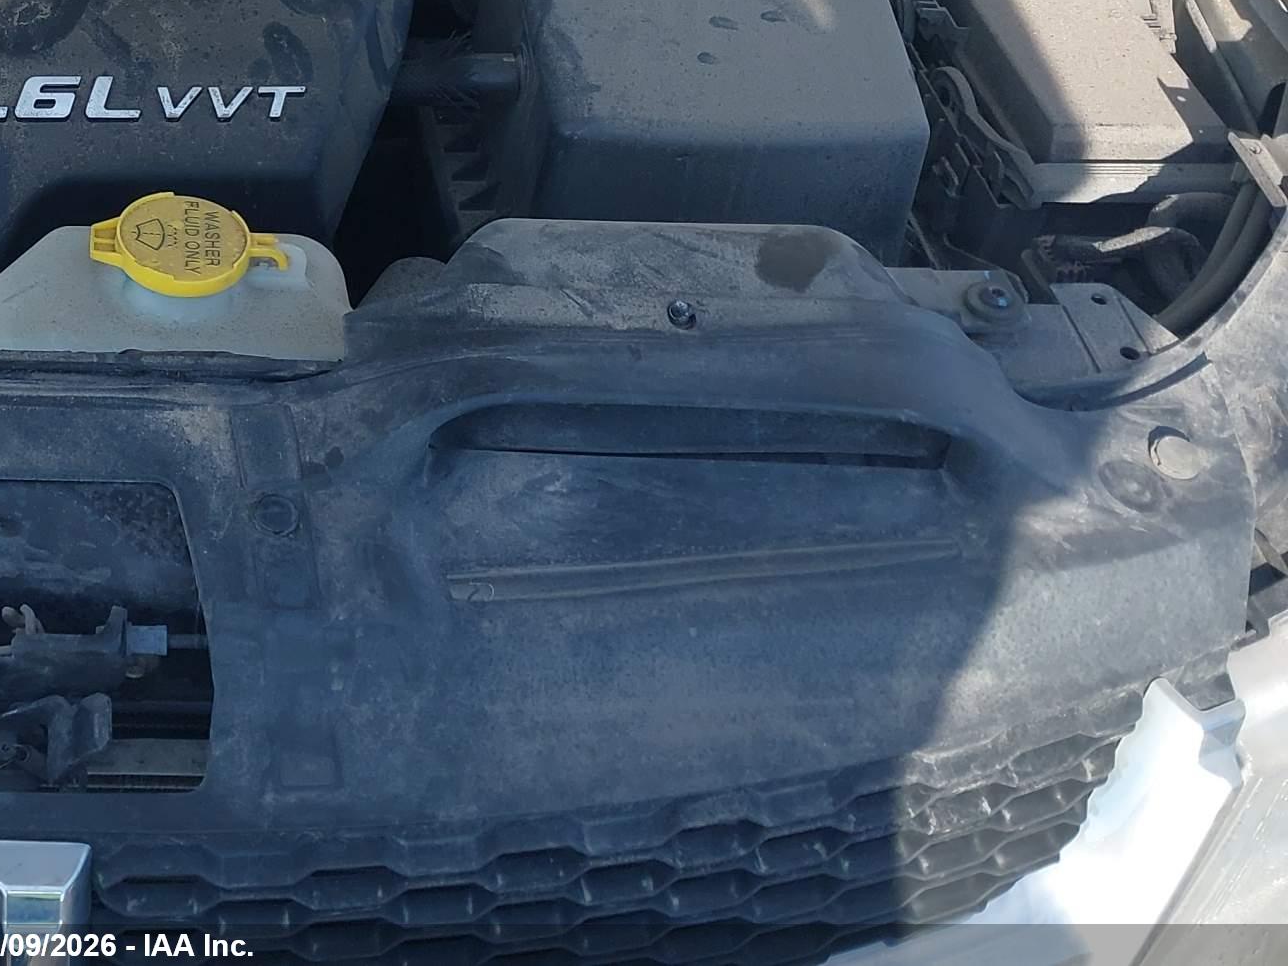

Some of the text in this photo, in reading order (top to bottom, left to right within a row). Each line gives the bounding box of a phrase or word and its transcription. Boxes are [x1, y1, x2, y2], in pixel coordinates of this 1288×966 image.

[157, 86, 306, 121] VVT
[184, 200, 202, 275] FLUID ONLY
[205, 211, 221, 267] WASHER
